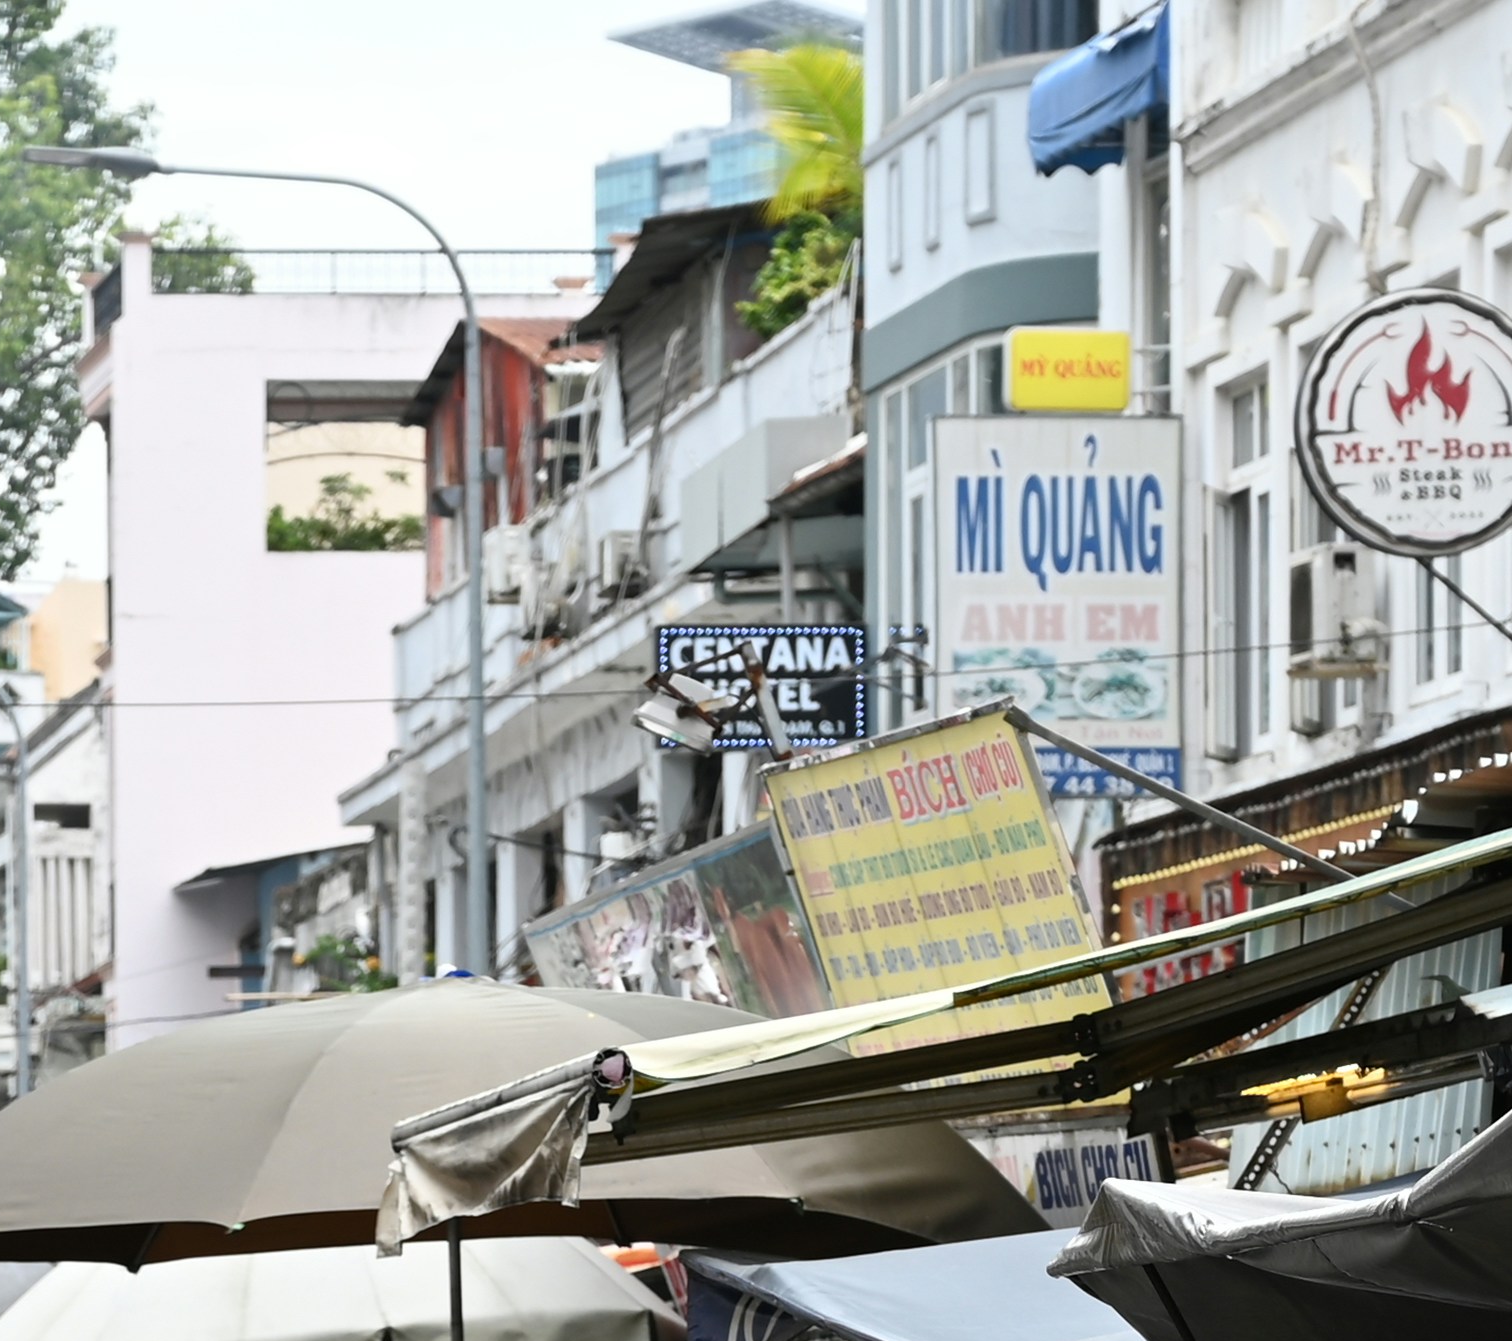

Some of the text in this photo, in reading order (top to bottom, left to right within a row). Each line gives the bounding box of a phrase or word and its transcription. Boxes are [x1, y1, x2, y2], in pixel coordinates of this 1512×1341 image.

[1053, 353, 1122, 378] QUẢNG
[1398, 466, 1464, 482] Steak
[1416, 484, 1463, 501] BBQ
[955, 433, 1163, 592] MÌ QUẢNG
[961, 603, 1159, 641] ANH EM
[887, 750, 968, 822] BÍCH
